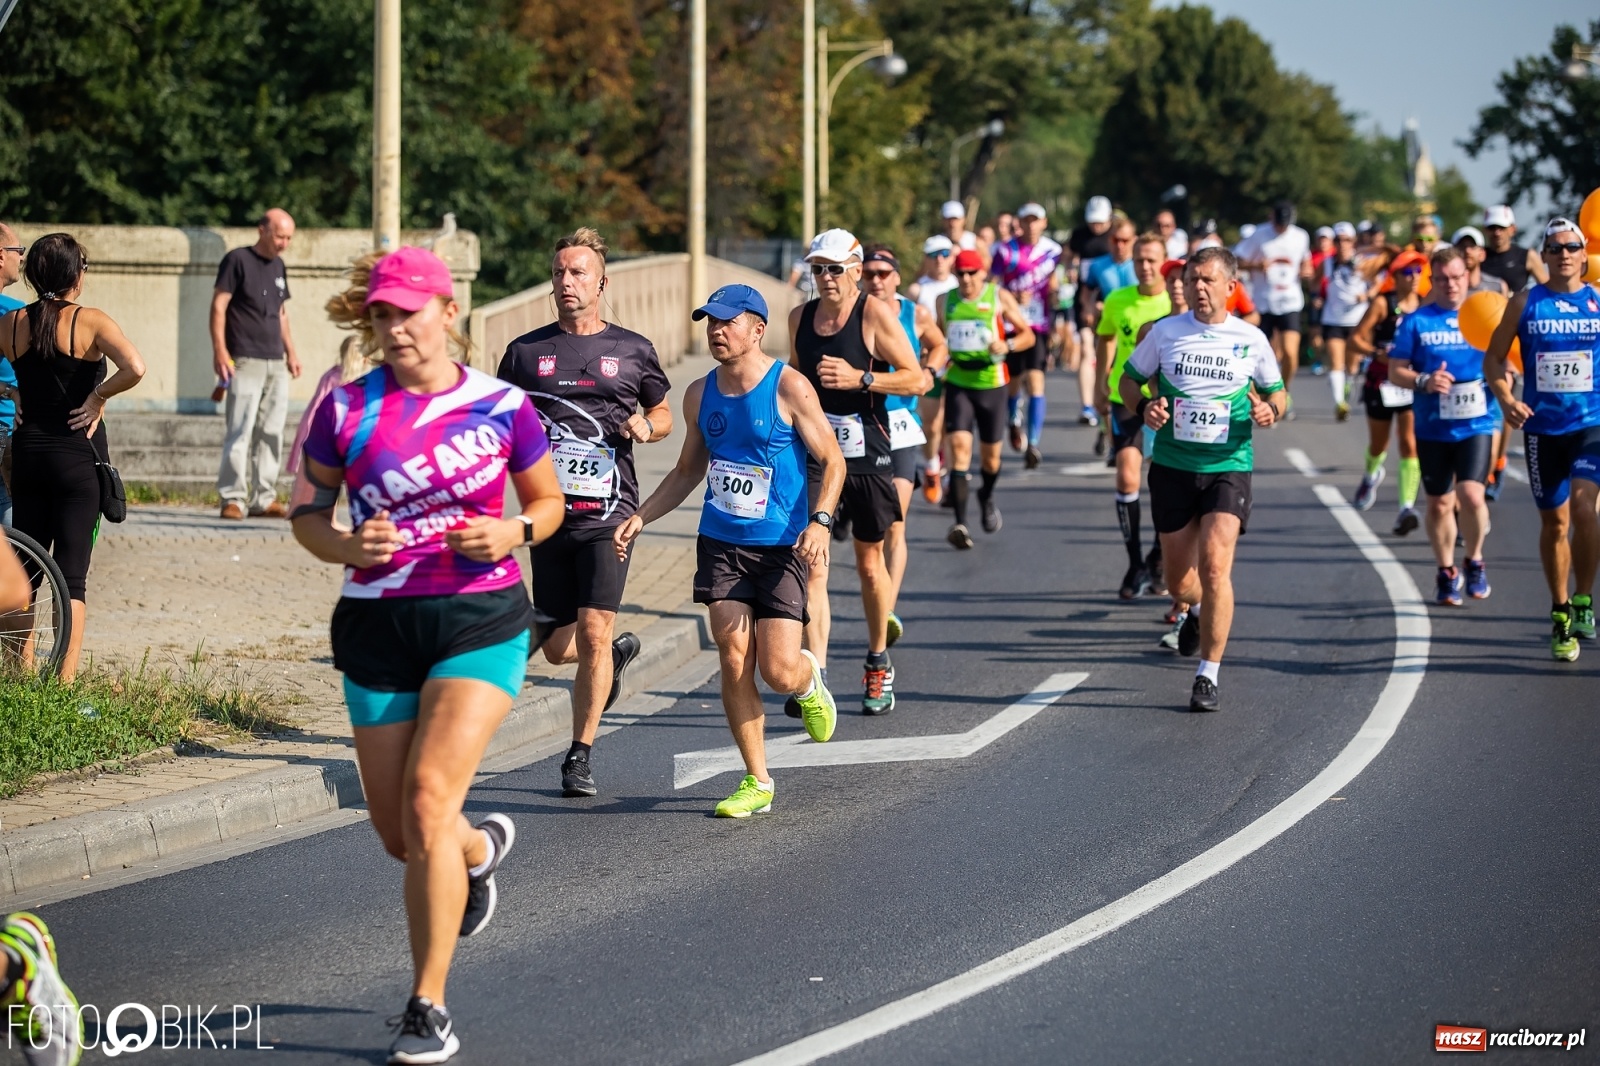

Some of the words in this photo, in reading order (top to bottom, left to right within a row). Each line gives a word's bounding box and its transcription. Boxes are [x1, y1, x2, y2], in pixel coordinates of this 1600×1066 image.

[1181, 352, 1213, 366] TEAM
[1215, 356, 1231, 367] OF
[1174, 363, 1234, 381] RUNNERS
[1553, 363, 1579, 377] 376
[1189, 411, 1217, 425] 242
[834, 427, 850, 441] 13
[567, 458, 599, 477] 255
[1527, 434, 1544, 499] RUNNERS
[722, 476, 753, 496] 500
